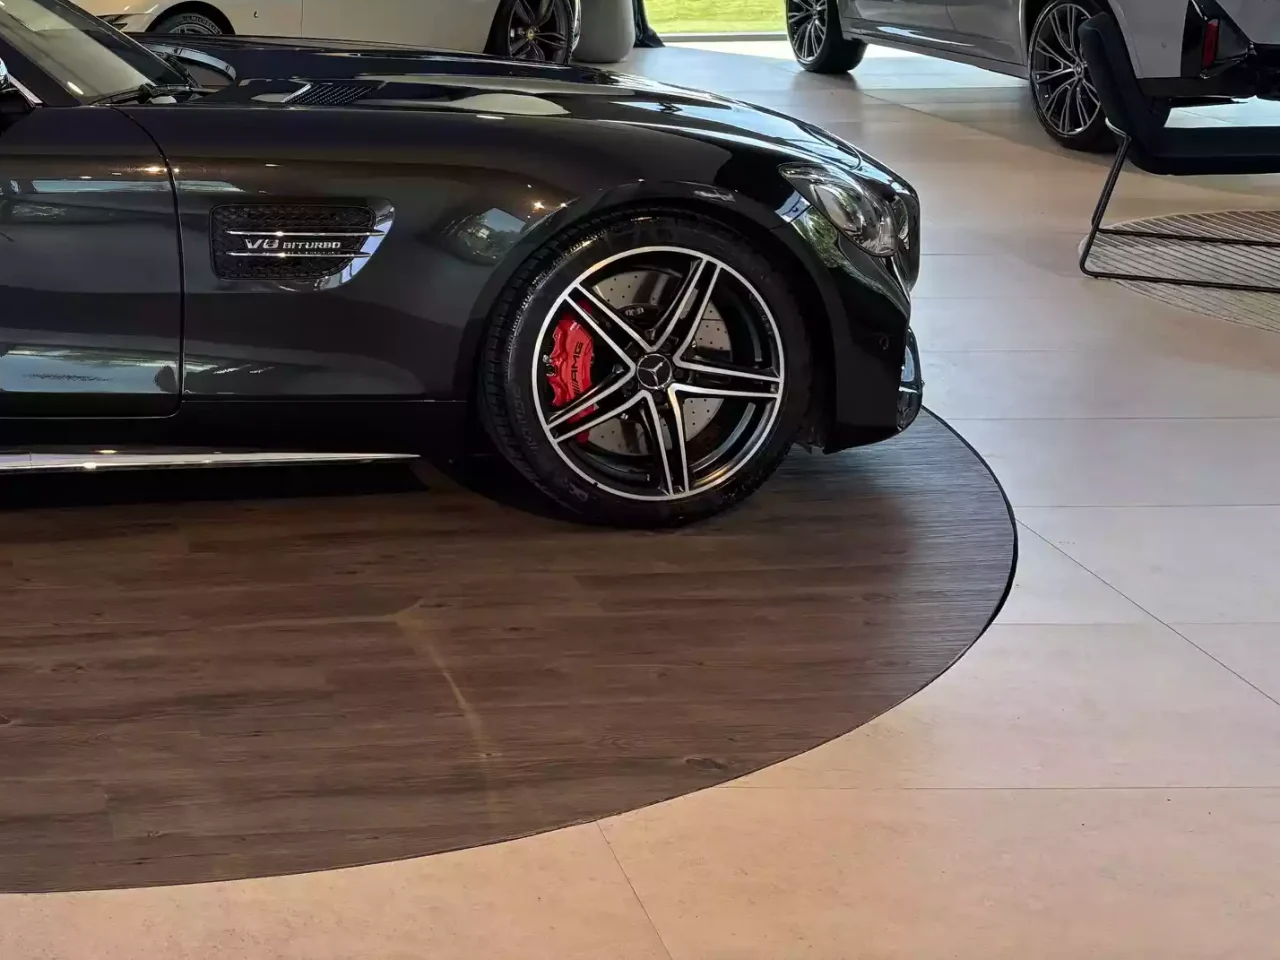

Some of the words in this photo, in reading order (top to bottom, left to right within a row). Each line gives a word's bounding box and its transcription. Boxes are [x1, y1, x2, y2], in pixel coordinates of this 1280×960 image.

[245, 238, 279, 249] V8
[282, 241, 341, 249] BITURBO
[571, 341, 584, 384] AMG
